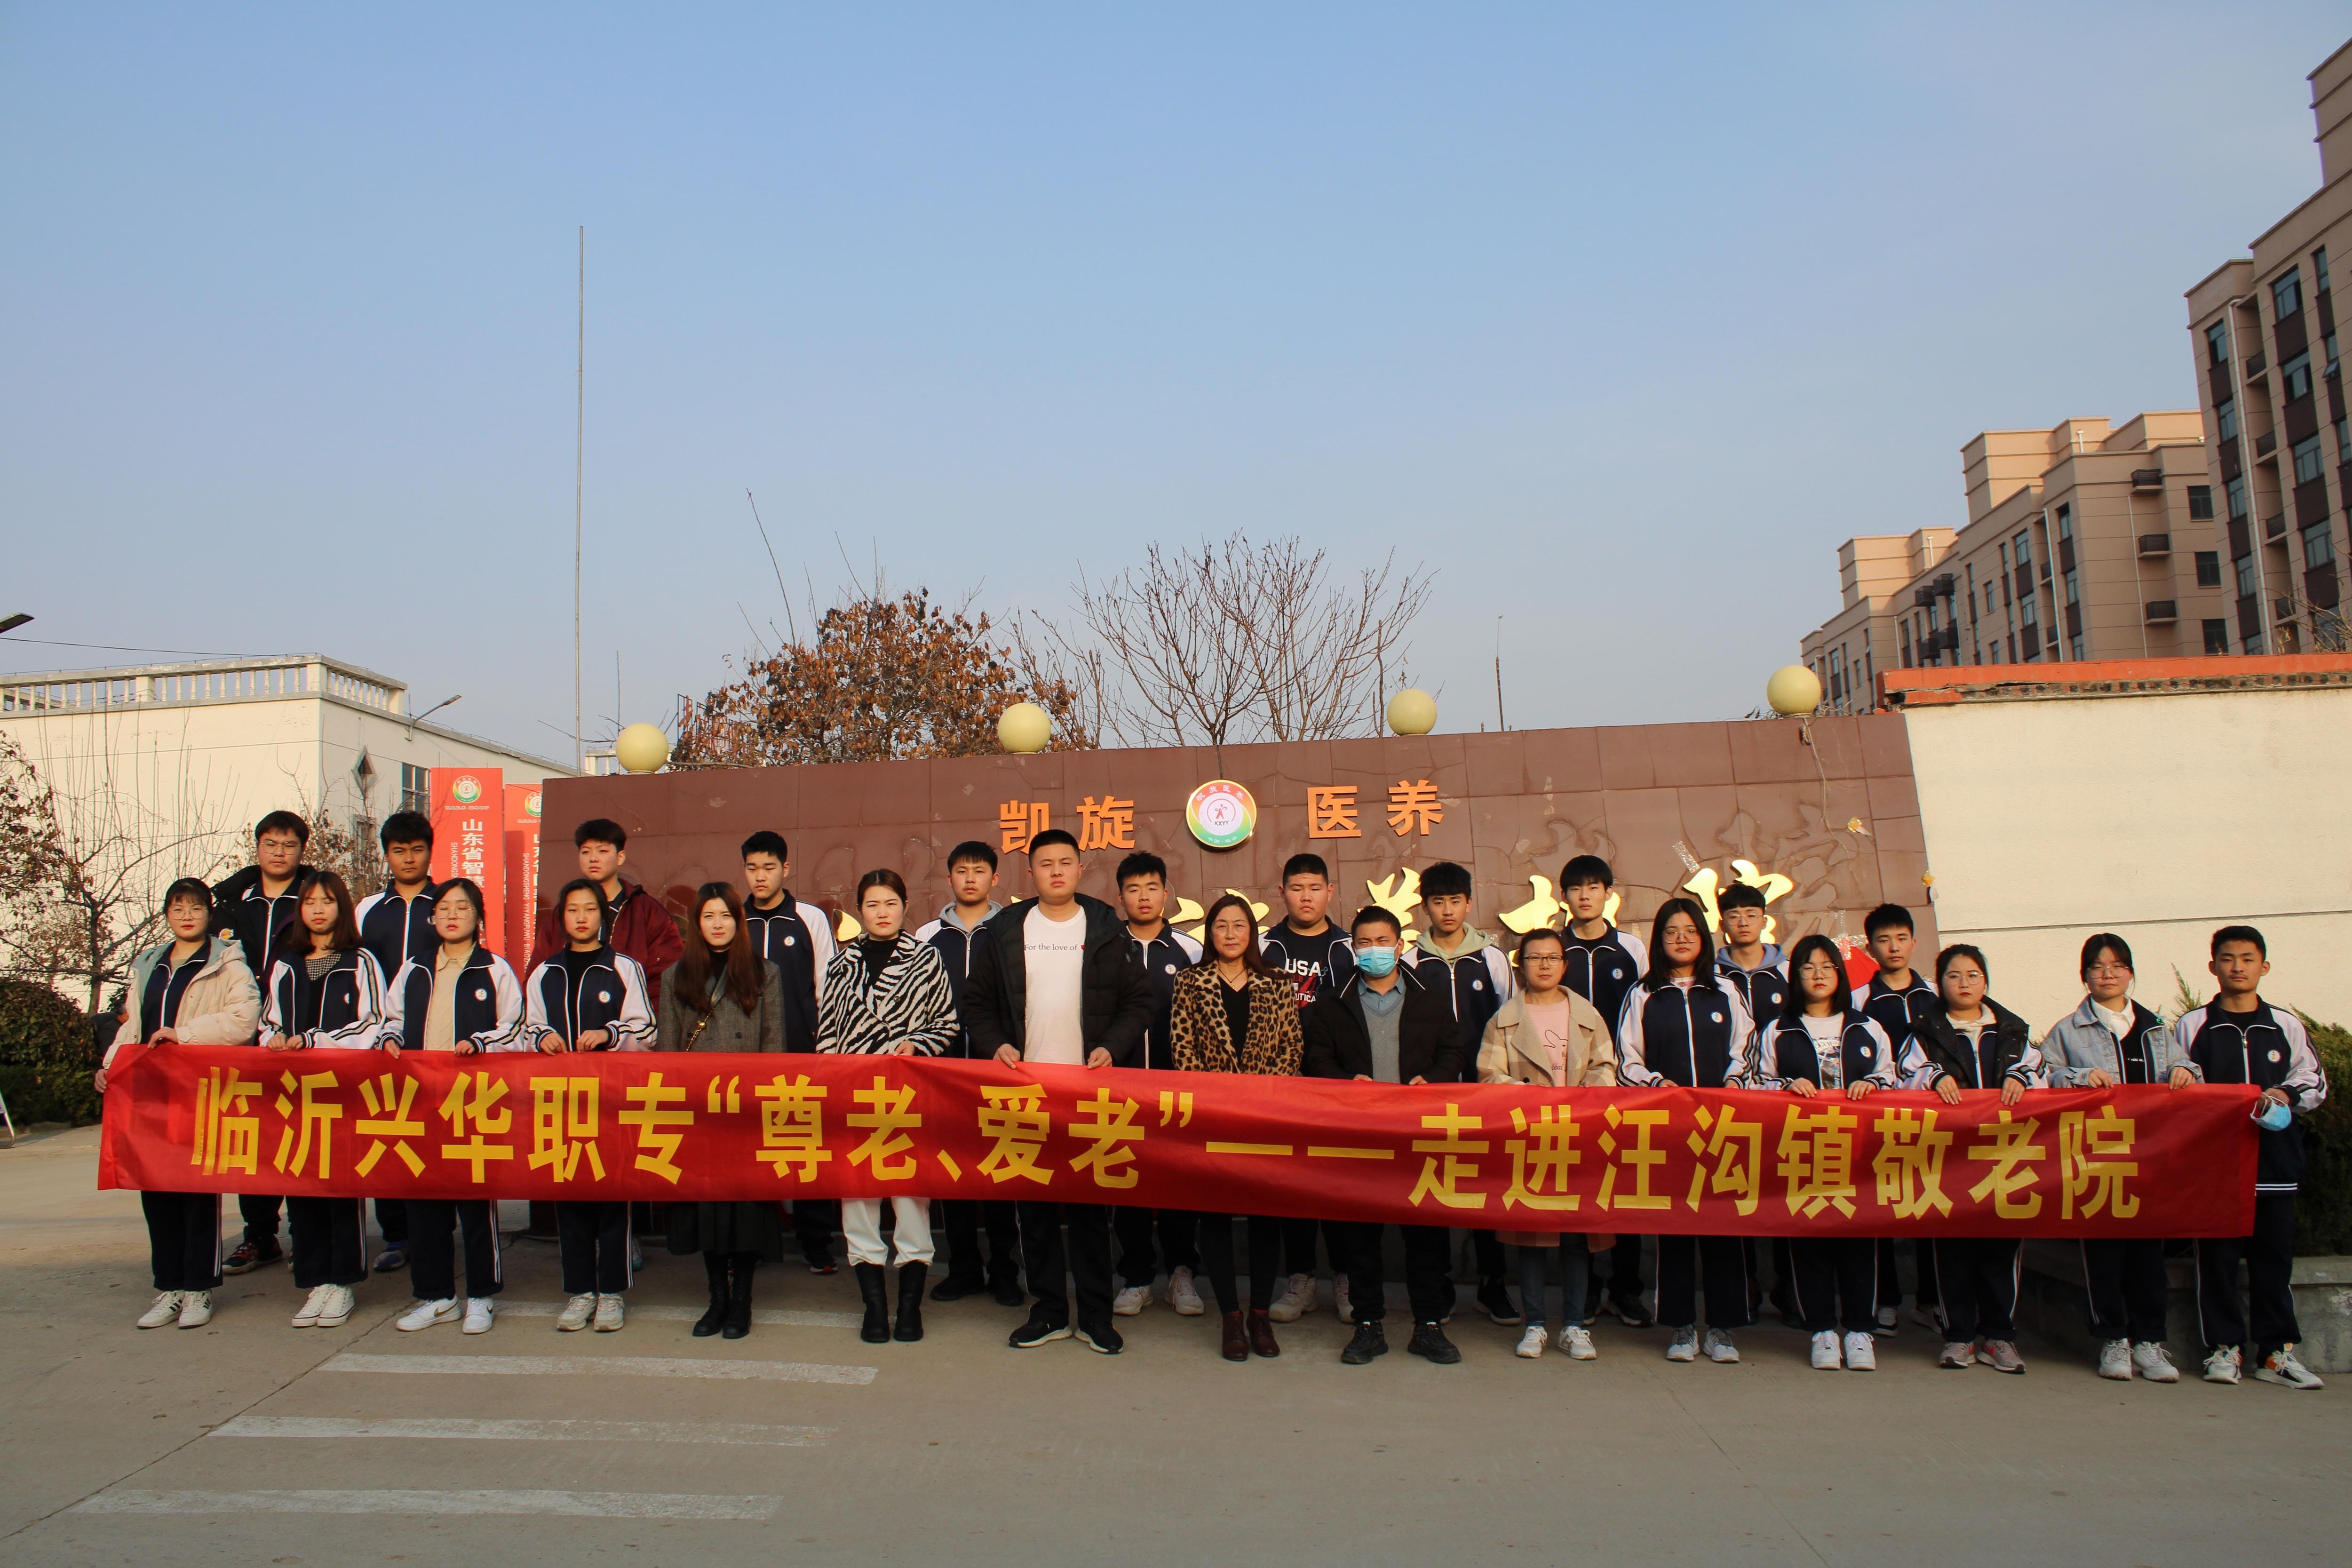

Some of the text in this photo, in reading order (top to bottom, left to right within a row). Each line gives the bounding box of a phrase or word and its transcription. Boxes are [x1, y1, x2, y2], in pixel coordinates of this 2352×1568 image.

[1196, 785, 1245, 801] 凯旋医养
[1000, 780, 1444, 855] 凯旋 医养
[1286, 958, 1321, 976] USA
[1295, 993, 1316, 1003] UTICA
